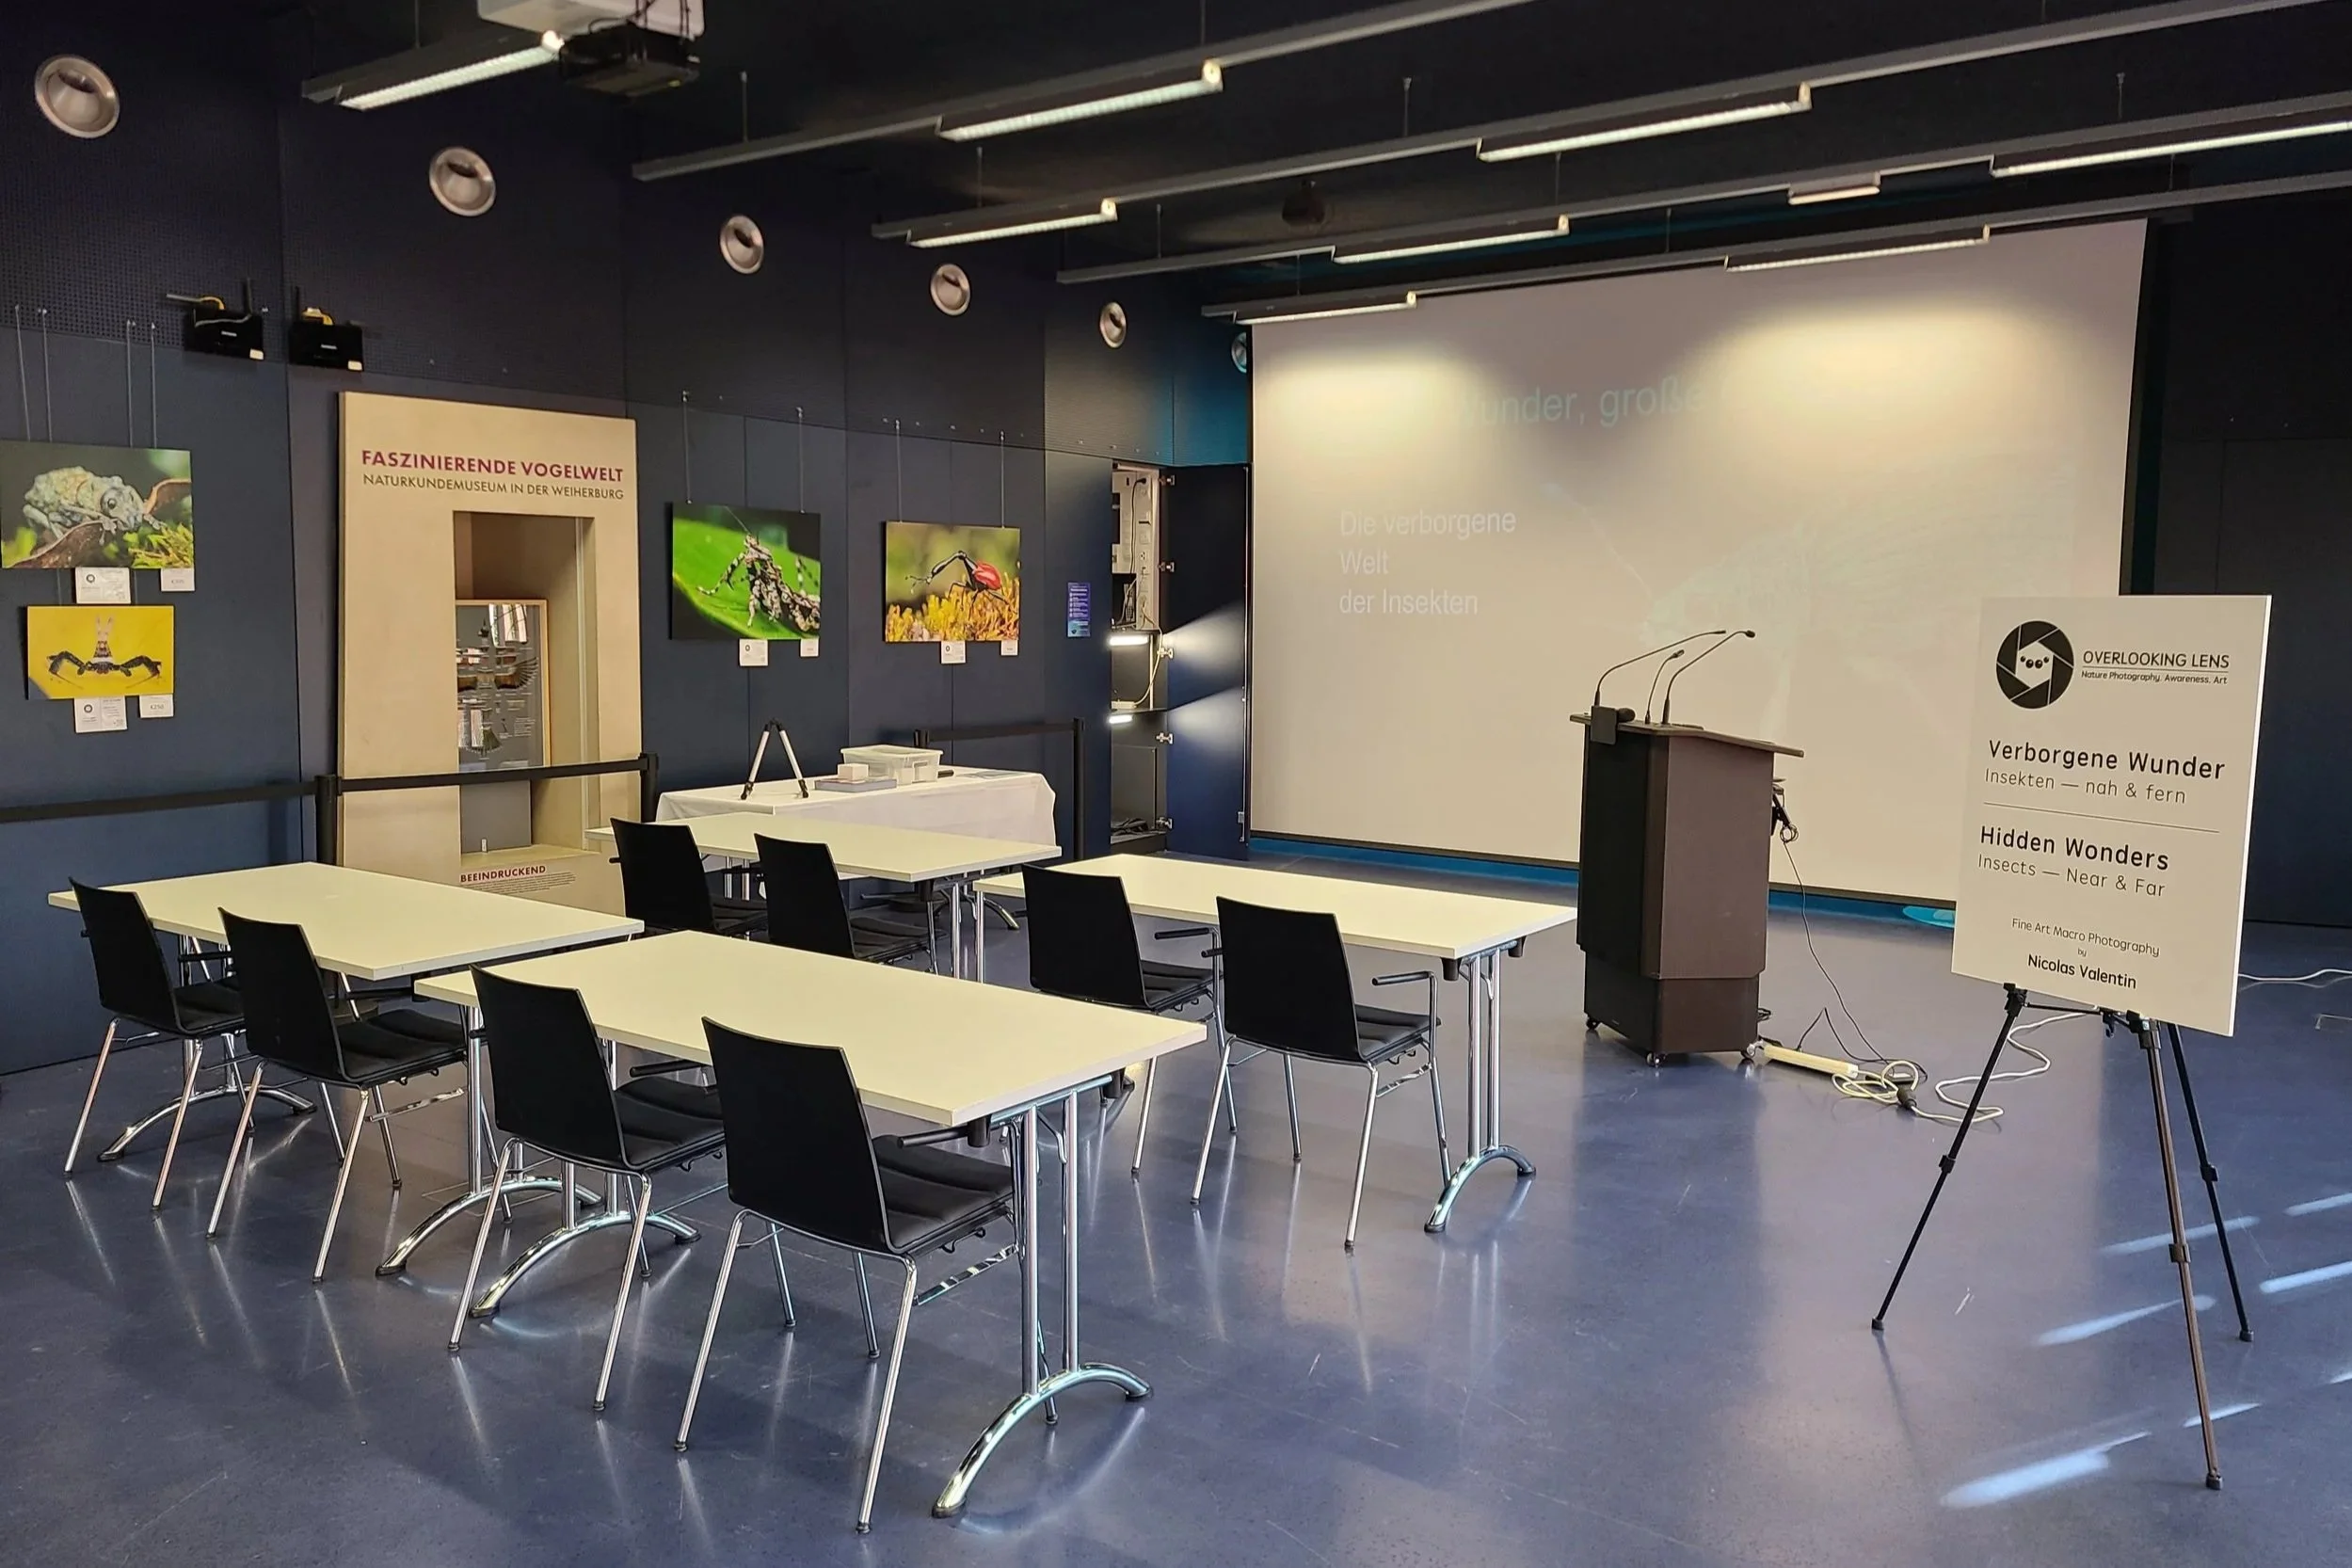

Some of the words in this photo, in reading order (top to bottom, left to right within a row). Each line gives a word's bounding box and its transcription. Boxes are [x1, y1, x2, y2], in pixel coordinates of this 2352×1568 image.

[362, 450, 516, 474] FASZINIERENDE
[520, 461, 623, 482] VOGELWELT
[363, 474, 507, 493] NATURKUNDEMUSEUM
[510, 483, 523, 494] IN
[527, 485, 549, 496] DER
[552, 486, 624, 500] WEIHERBURG
[1340, 509, 1376, 536] Die
[1384, 508, 1517, 540] verborgene
[1340, 549, 1389, 575] Welt
[1339, 588, 1375, 615] der
[1383, 587, 1479, 615] Insekten
[2083, 650, 2187, 667] OVERLOOKING
[2191, 653, 2230, 669] LENS
[2081, 670, 2107, 680] Nature
[2165, 674, 2211, 684] Awareness.
[2213, 676, 2228, 684] Art
[1989, 740, 2118, 769] Verborgene
[2129, 752, 2225, 779] Wunder
[1985, 768, 2055, 790] Insekten
[2086, 779, 2118, 796] nah
[2125, 782, 2137, 798] &
[2146, 784, 2185, 804] fern
[1980, 825, 2055, 854] Hidden
[2066, 837, 2168, 871] Wonders
[460, 865, 546, 883] BEEINDRUCKEND
[1978, 854, 2036, 876] Insects
[2067, 868, 2107, 888] Near
[2115, 875, 2127, 890] &
[2136, 878, 2165, 897] Far
[2012, 918, 2032, 931] Fine
[2034, 922, 2051, 935] Art
[2053, 926, 2086, 941] Macro
[2088, 933, 2160, 958] Photography
[2077, 948, 2088, 957] by
[2028, 953, 2075, 975] Nicolas
[2079, 965, 2137, 989] Valentin
